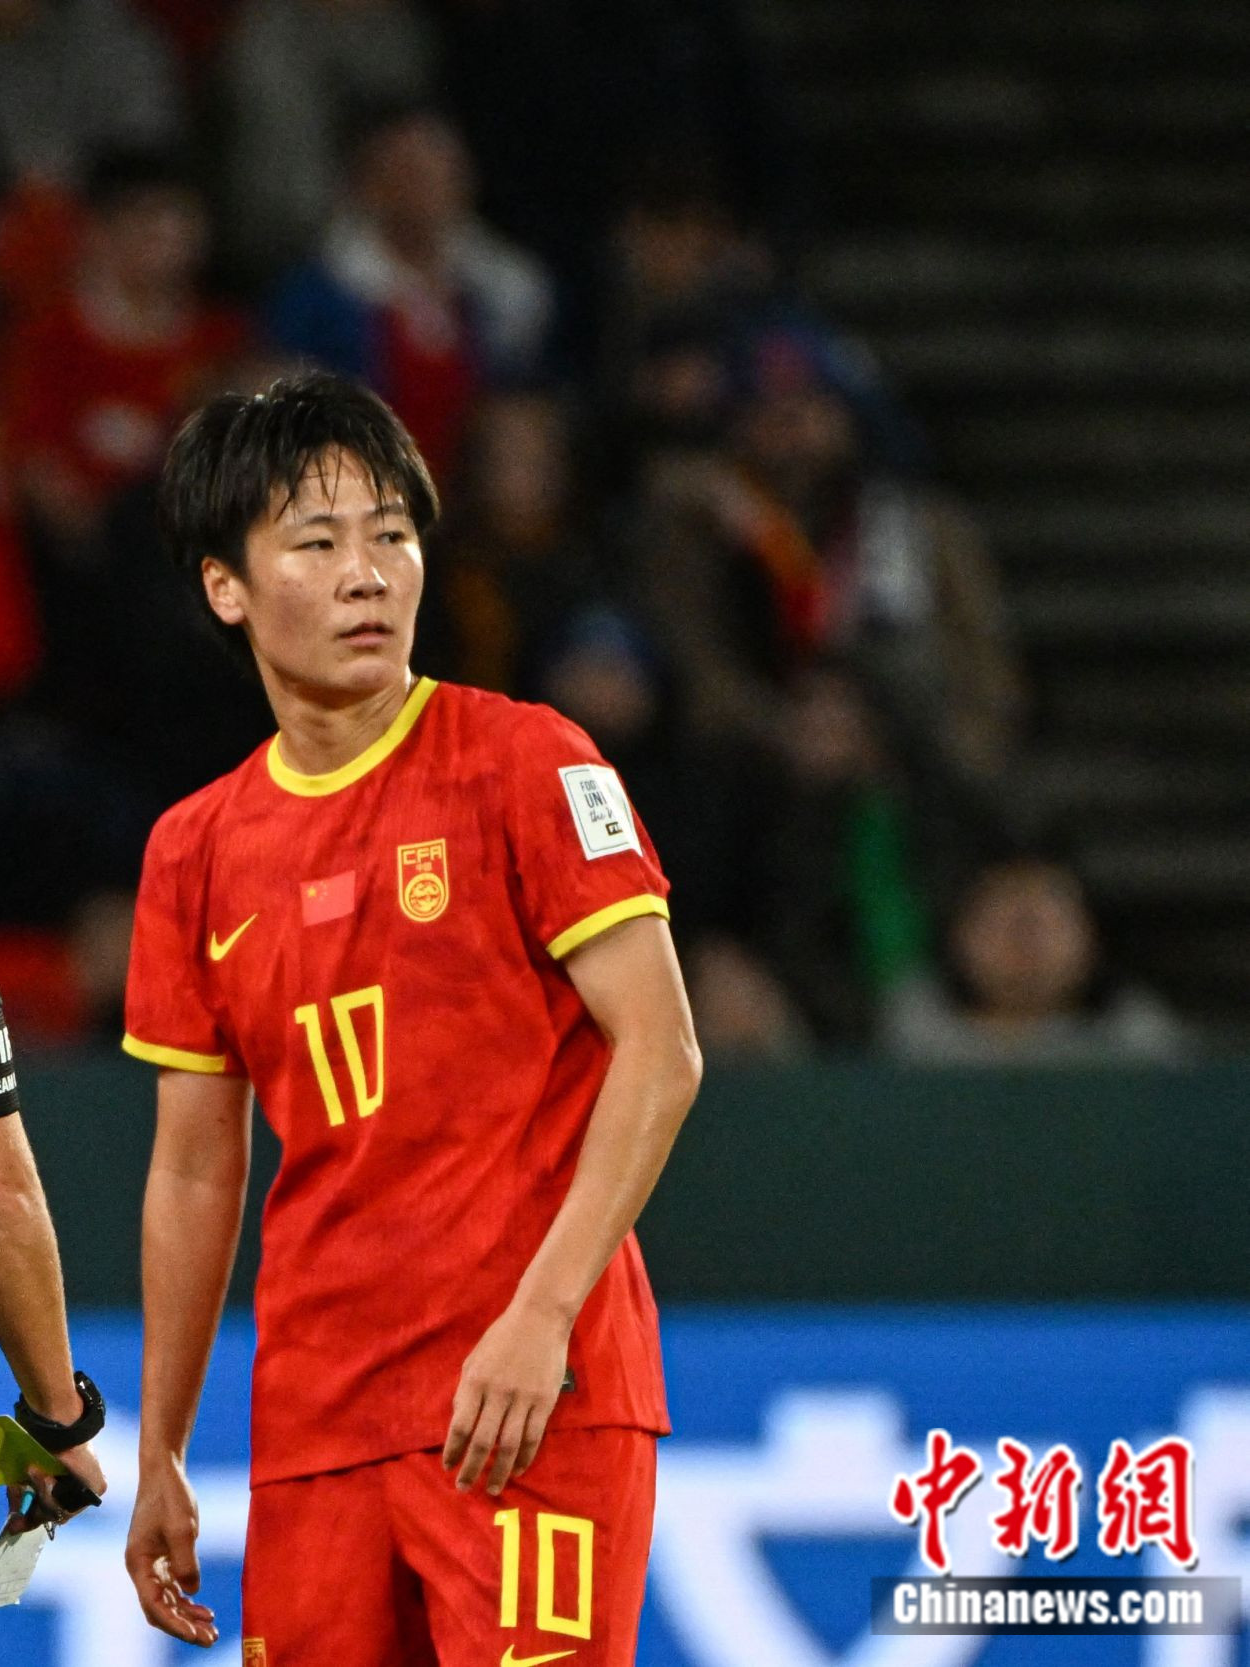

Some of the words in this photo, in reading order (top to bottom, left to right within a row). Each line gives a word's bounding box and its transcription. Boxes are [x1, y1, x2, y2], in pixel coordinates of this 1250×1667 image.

[403, 845, 442, 865] CFA
[294, 984, 384, 1127] 10
[494, 1508, 594, 1640] 10
